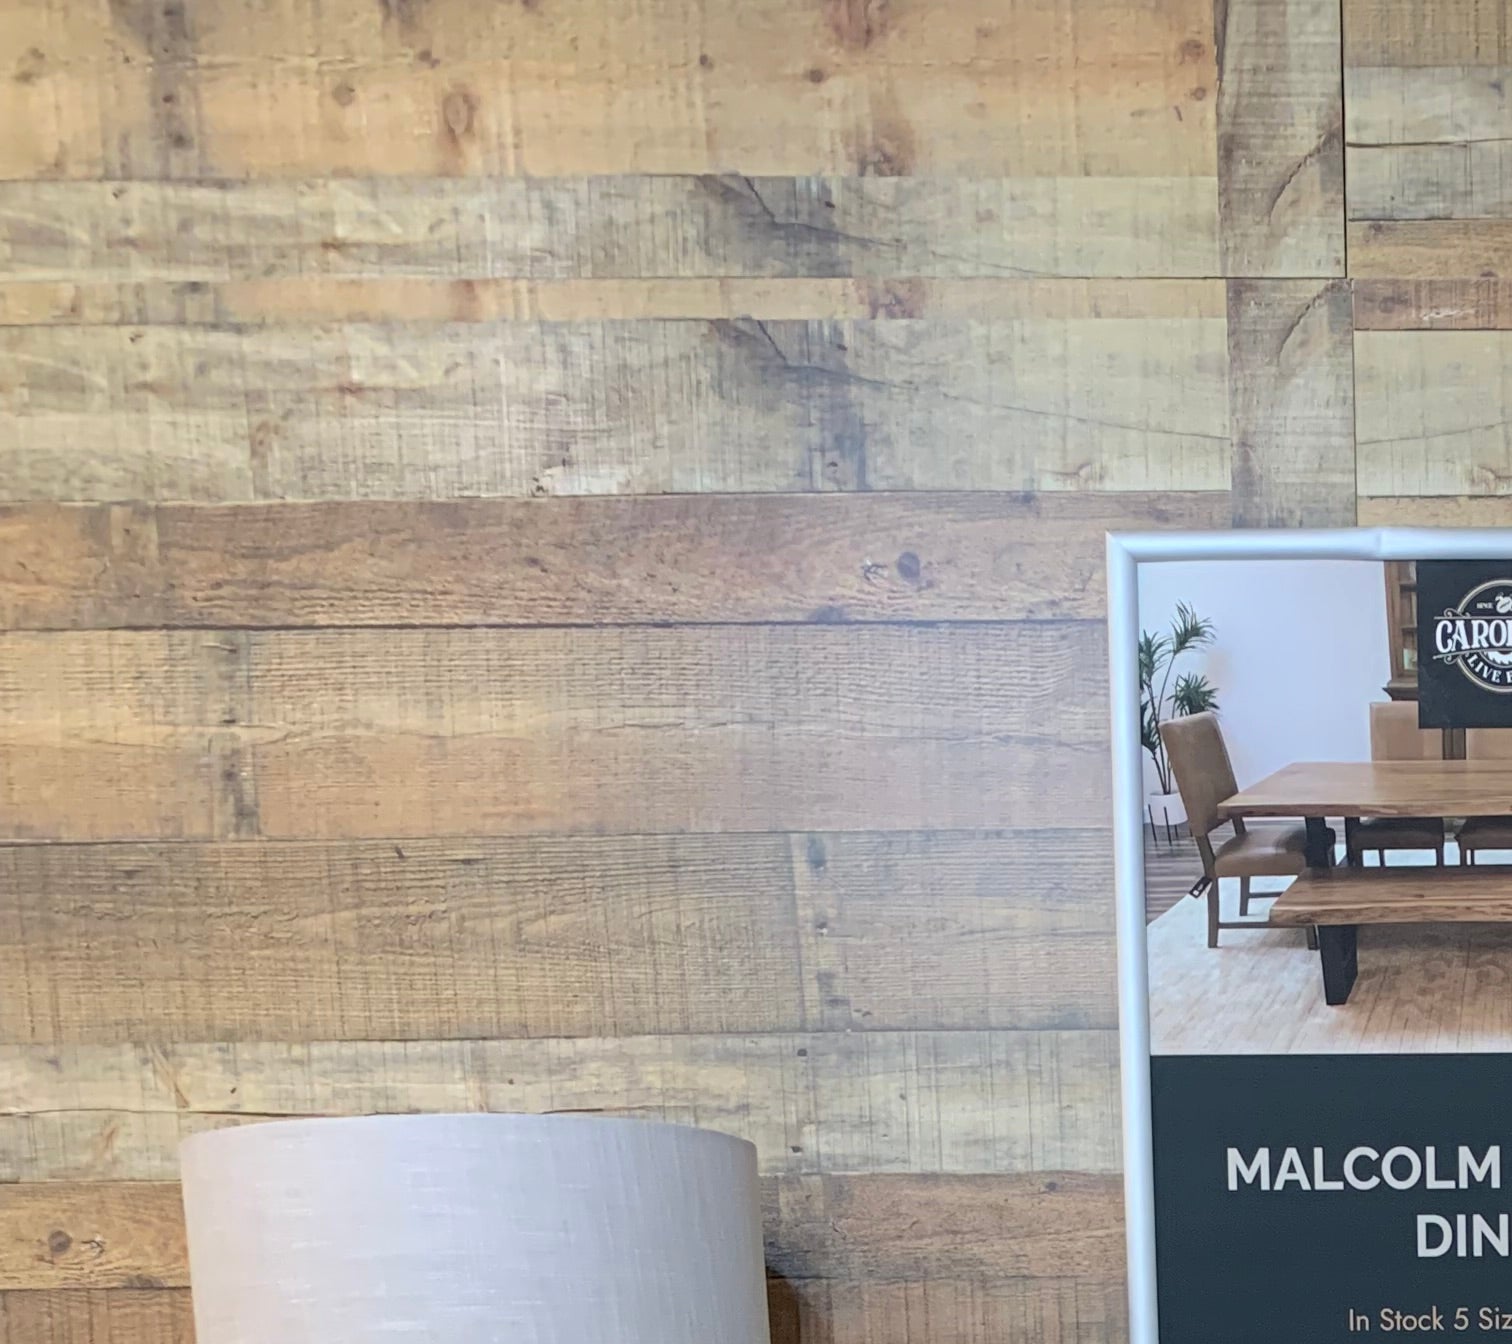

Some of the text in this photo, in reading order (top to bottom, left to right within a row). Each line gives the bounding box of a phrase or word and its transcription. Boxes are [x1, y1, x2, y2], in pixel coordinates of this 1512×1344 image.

[1466, 653, 1502, 684] LIVE
[1226, 1145, 1501, 1191] MALCOLM
[1348, 1308, 1370, 1332] In
[1379, 1305, 1445, 1332] Stock
[1453, 1307, 1470, 1331] 5
